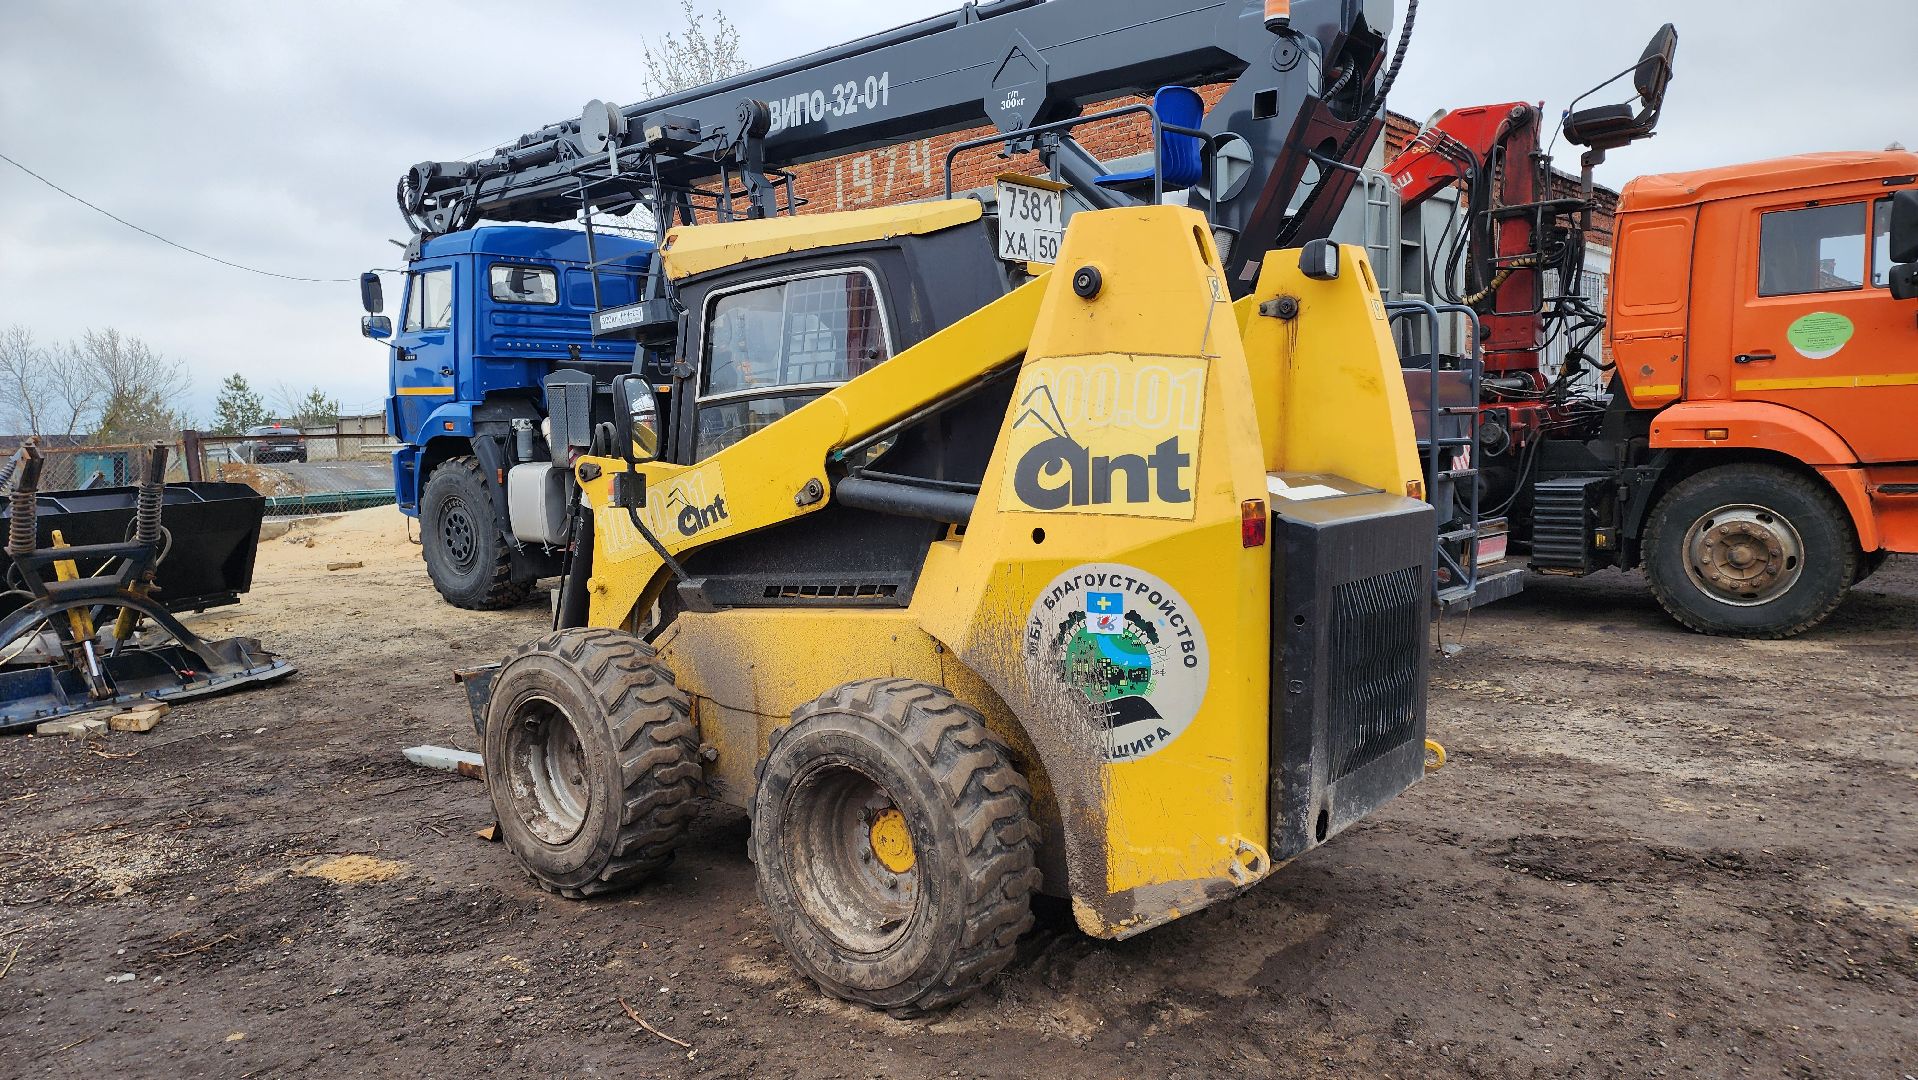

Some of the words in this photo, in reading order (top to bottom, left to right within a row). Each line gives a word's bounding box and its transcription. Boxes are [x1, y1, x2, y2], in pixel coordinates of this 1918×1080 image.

[769, 71, 889, 132] ВИПО-32-01
[835, 137, 932, 209] 1974
[1005, 186, 1053, 224] 7381
[1004, 229, 1028, 257] ХА
[1039, 235, 1058, 260] 50
[1013, 436, 1192, 511] ant
[677, 493, 729, 537] ant
[1043, 573, 1198, 669] БЛАГОУСТРОЙСТВО
[1106, 726, 1172, 760] ШИРА
